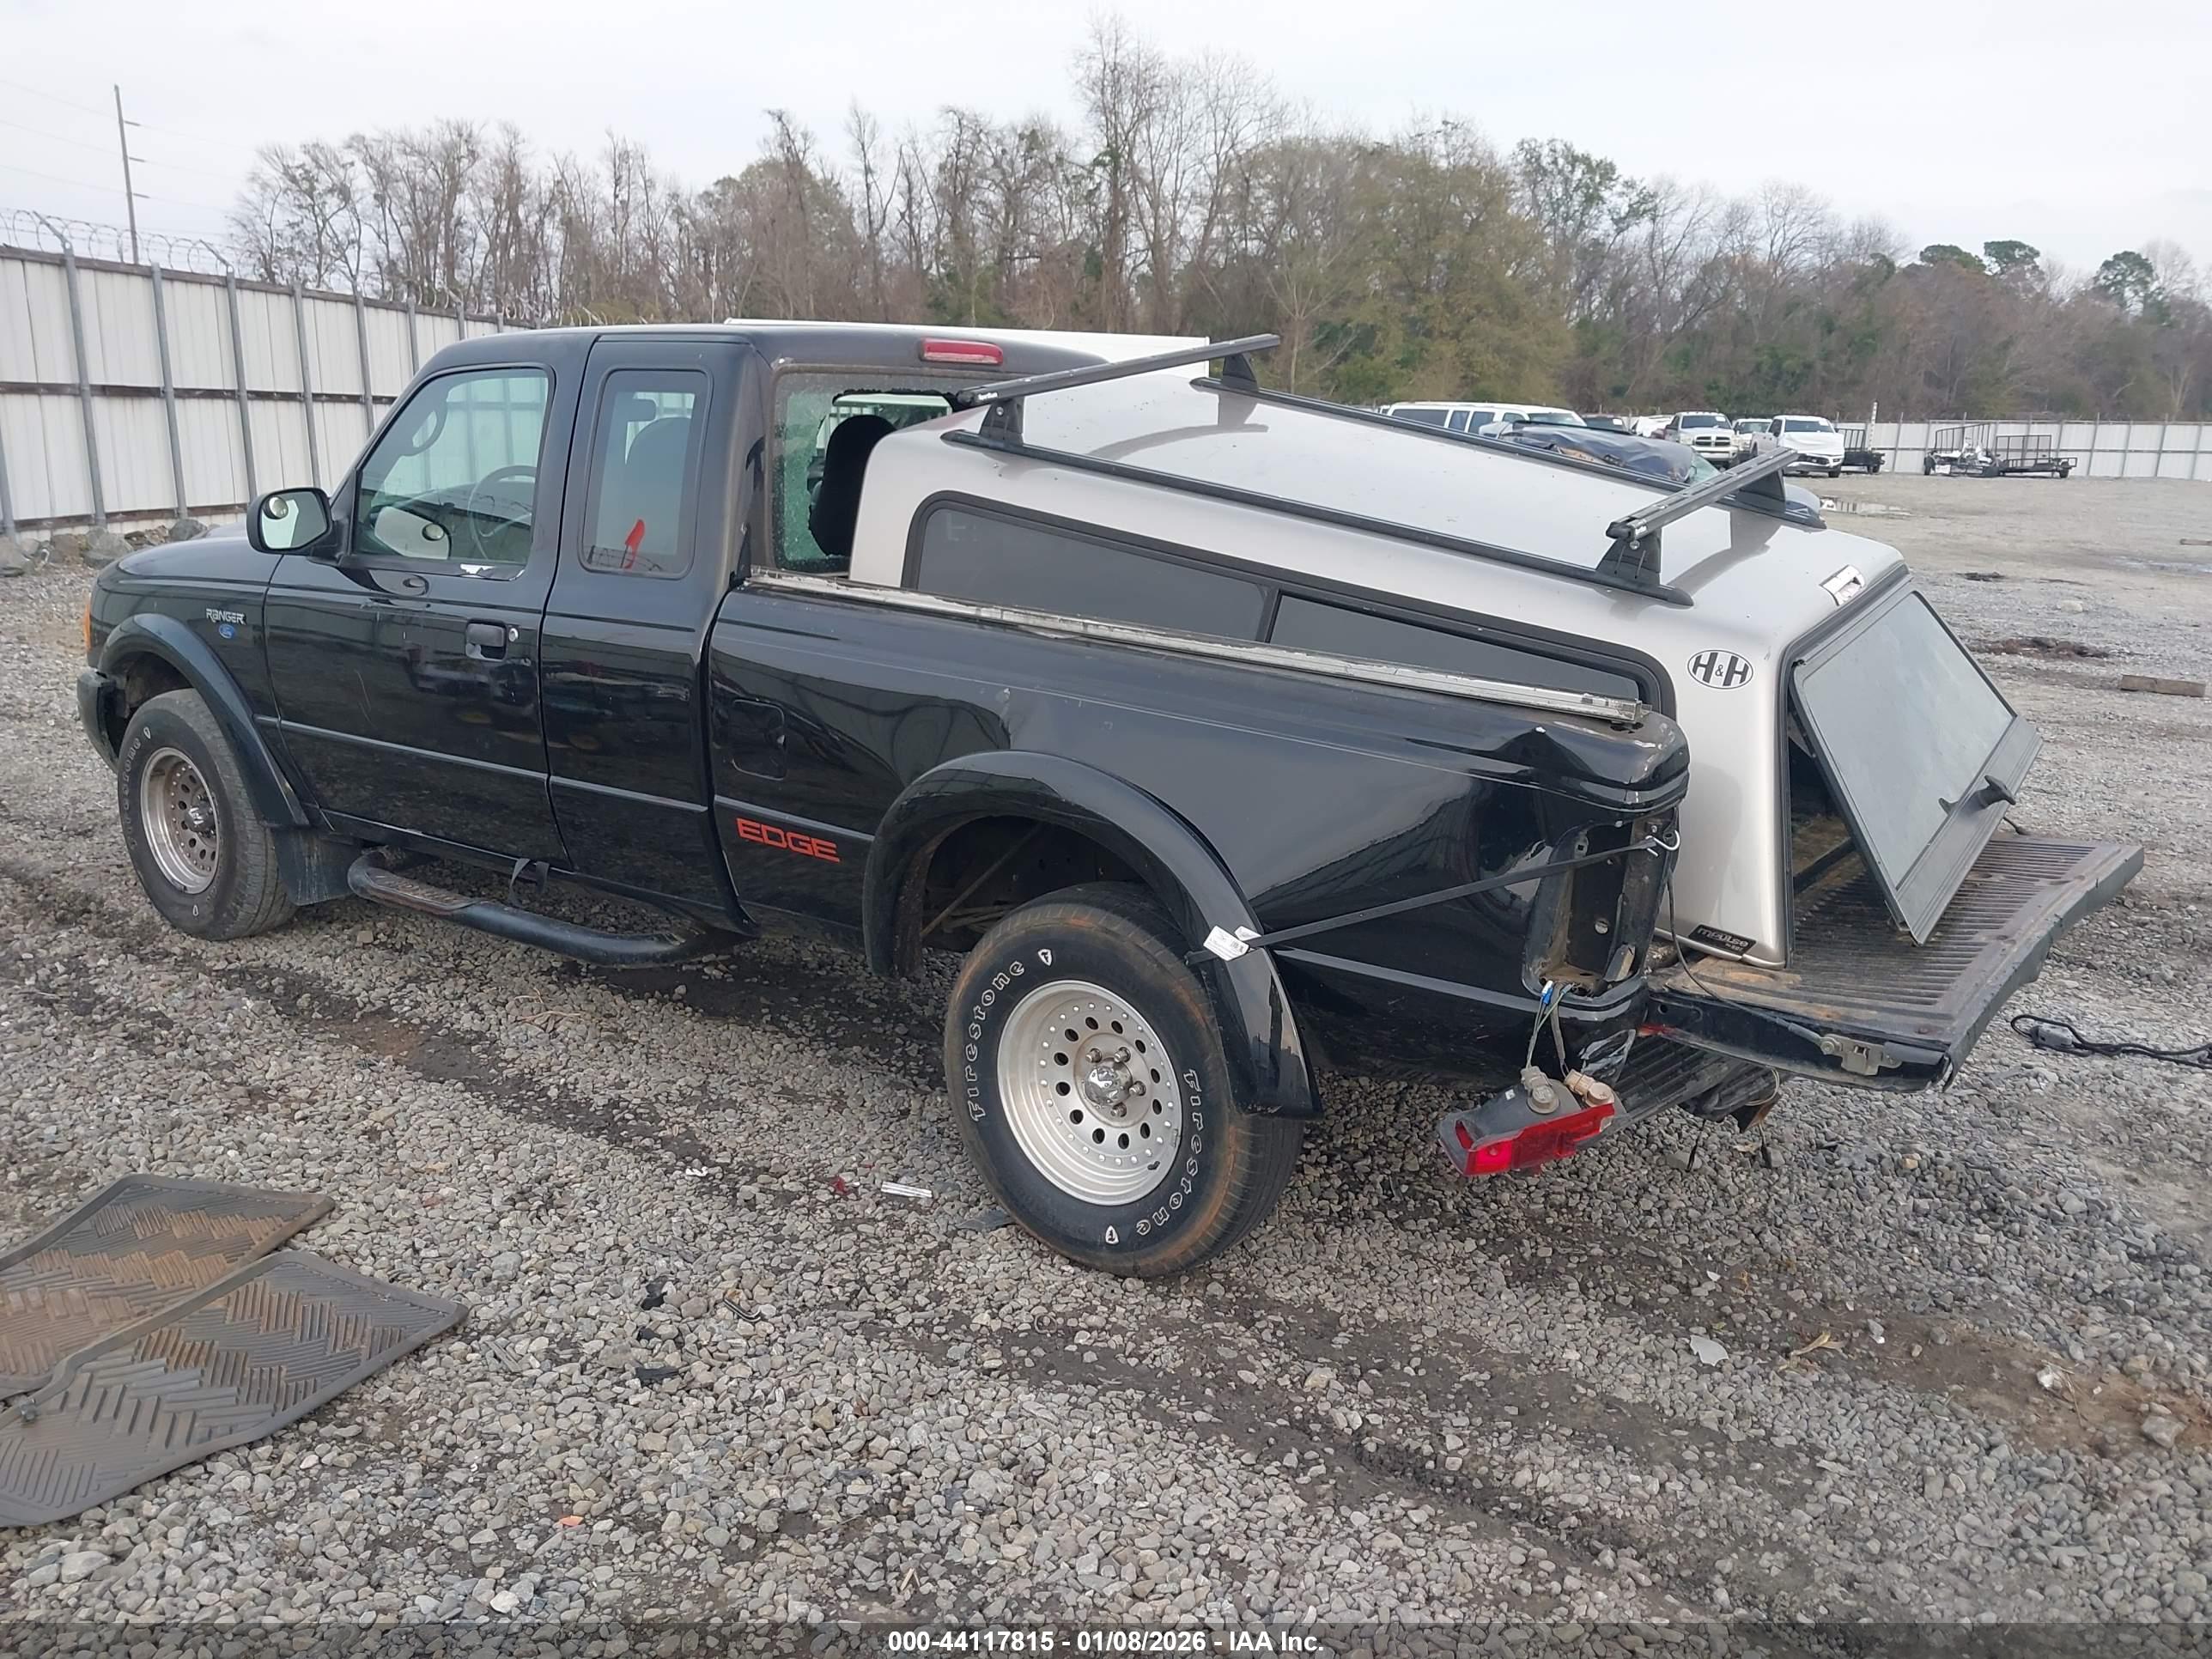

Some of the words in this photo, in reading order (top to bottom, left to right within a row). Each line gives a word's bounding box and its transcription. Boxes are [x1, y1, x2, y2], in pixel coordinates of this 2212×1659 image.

[205, 608, 246, 625] RANGER
[1692, 652, 1749, 687] H&H
[736, 817, 840, 863] EDGE
[965, 961, 1024, 1121] Firestone
[1135, 1069, 1203, 1236] Firestone
